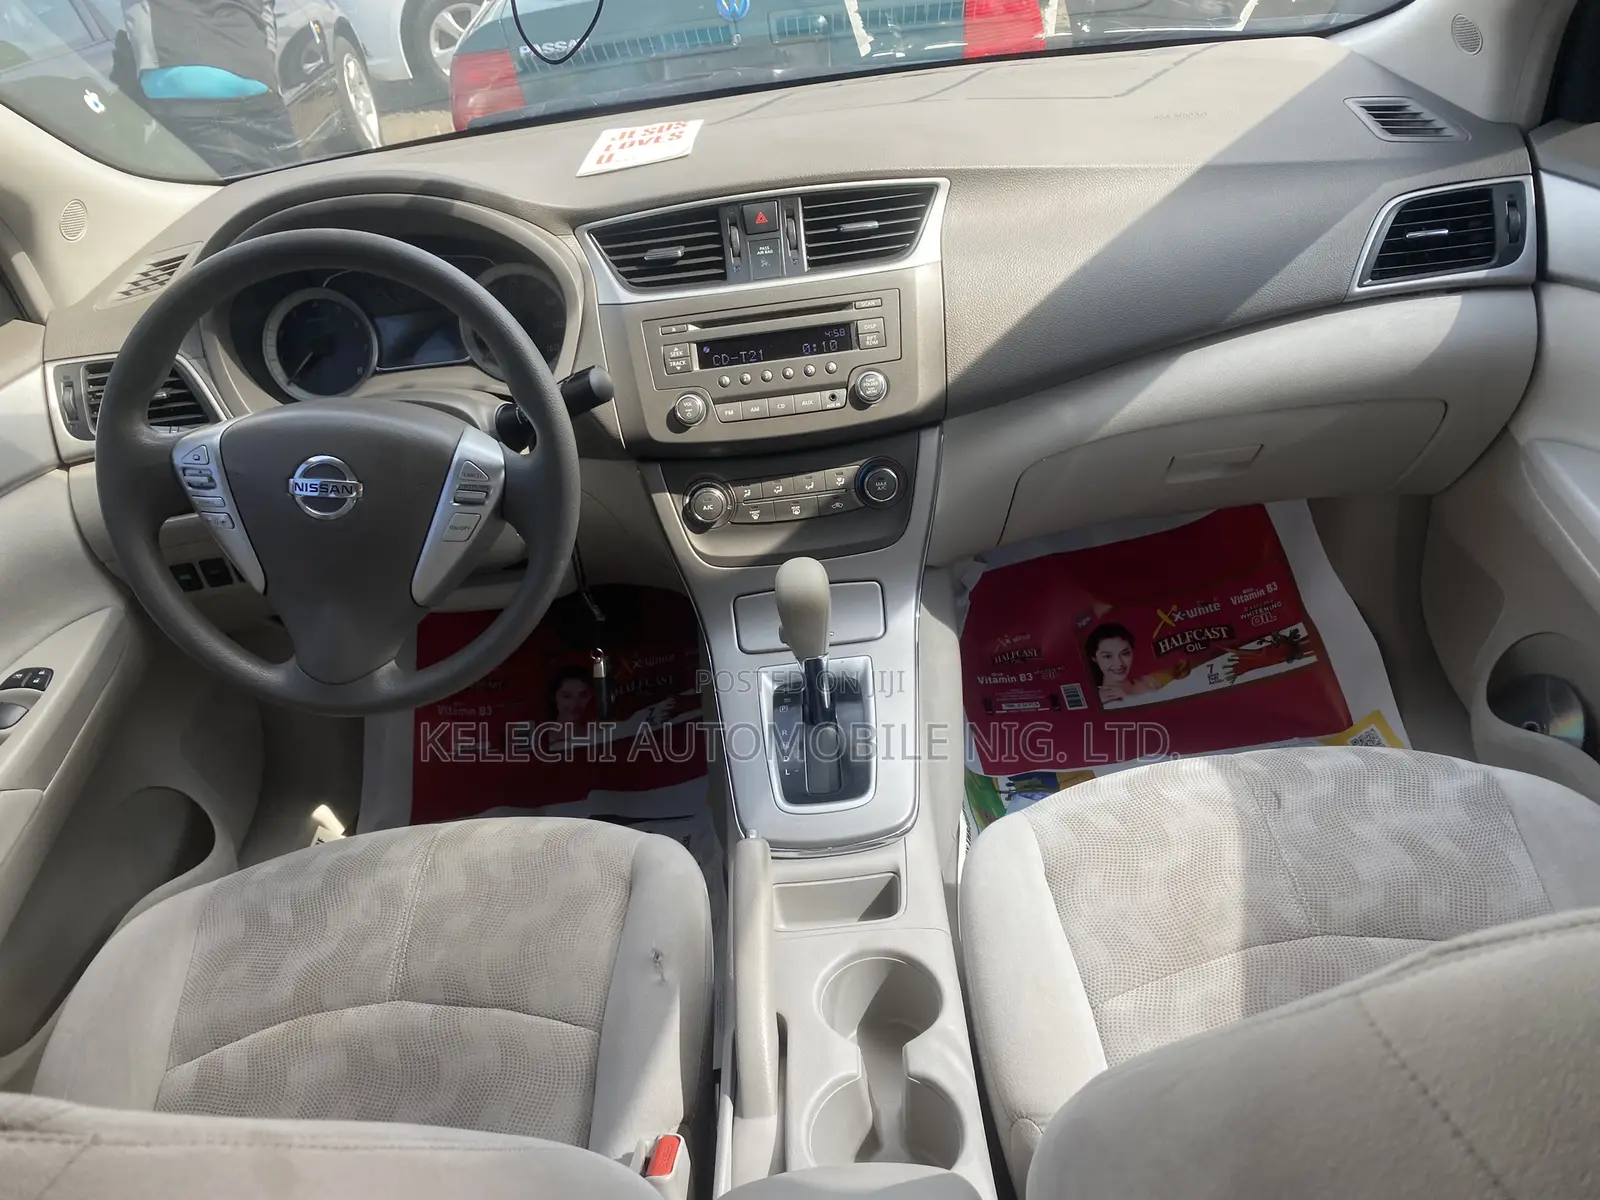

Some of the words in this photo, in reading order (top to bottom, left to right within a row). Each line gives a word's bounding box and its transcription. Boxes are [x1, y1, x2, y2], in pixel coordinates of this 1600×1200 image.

[825, 328, 846, 338] 4:58
[712, 349, 764, 366] CD-T21
[802, 340, 838, 354] 0:10
[294, 481, 354, 495] NISSAN
[1230, 588, 1265, 606] Vitamin
[1266, 581, 1278, 594] B3
[1159, 626, 1229, 654] HALFCAST
[1187, 643, 1207, 653] OIL
[994, 648, 1038, 664] HALFCAST
[977, 675, 1017, 685] Vitamin
[1019, 672, 1034, 682] B3
